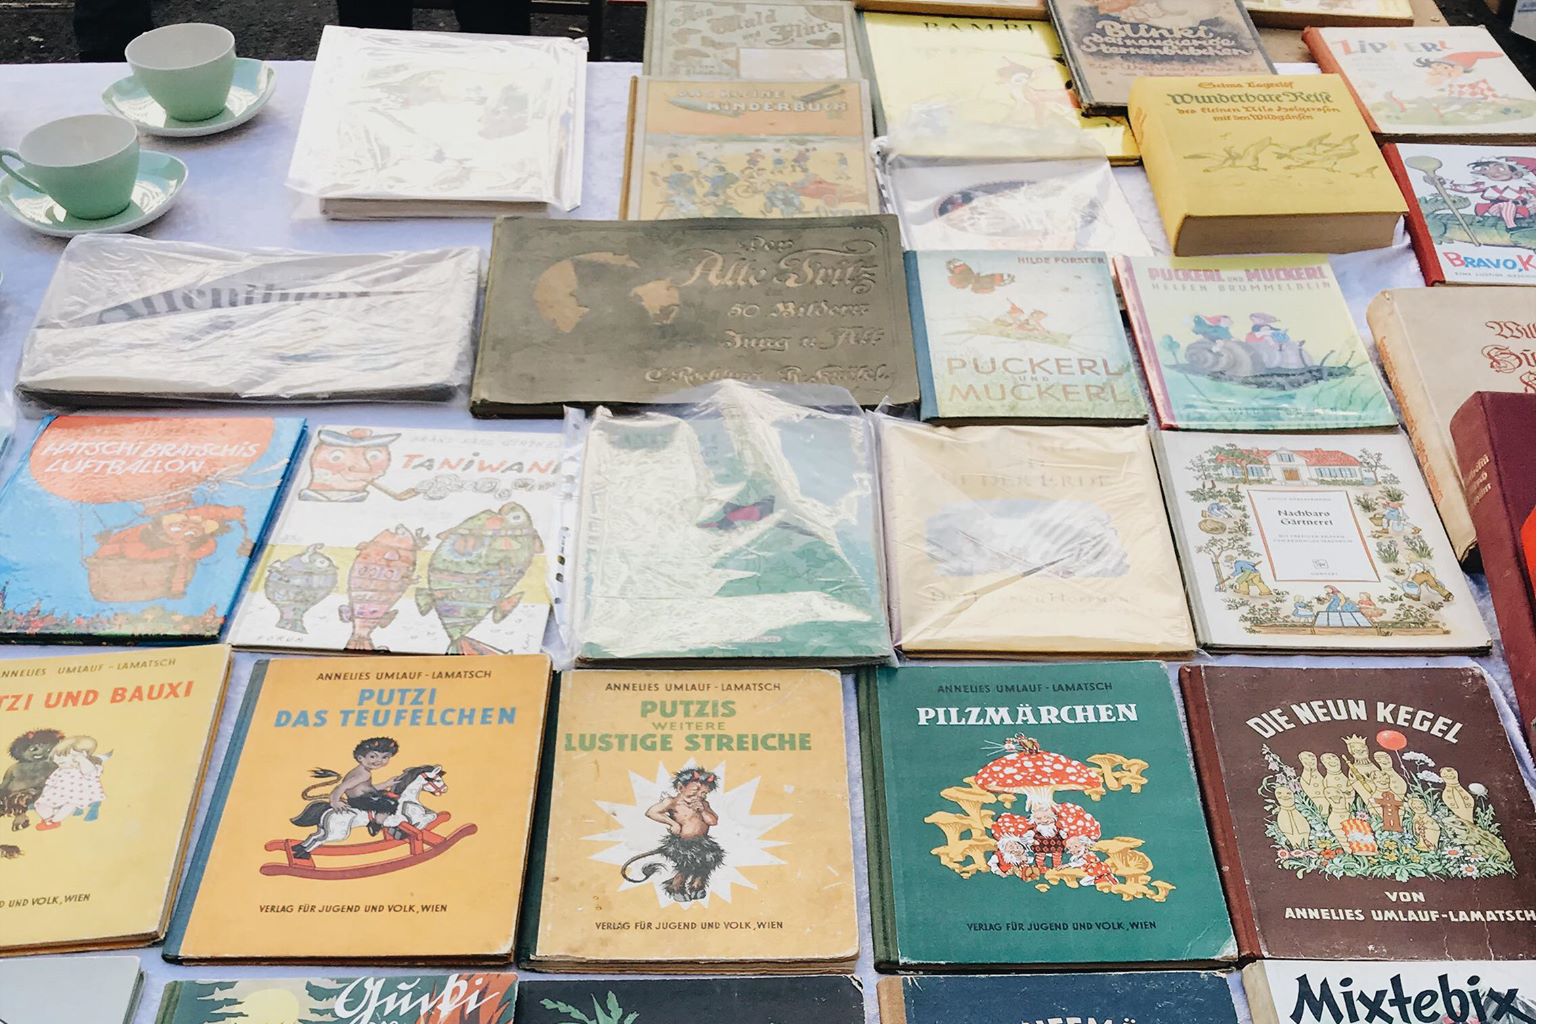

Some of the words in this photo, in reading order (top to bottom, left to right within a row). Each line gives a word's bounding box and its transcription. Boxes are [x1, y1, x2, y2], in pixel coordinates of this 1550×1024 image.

[1167, 92, 1282, 105] Wunderbare
[1017, 256, 1050, 264] HILDE
[1147, 267, 1226, 282] PUCKERL
[1244, 265, 1328, 282] MUCKERL
[1151, 283, 1208, 292] HELFEN
[728, 303, 761, 318] 50
[946, 357, 1125, 376] PUCKERL
[949, 382, 1131, 403] MUCKERL
[44, 457, 205, 476] LUFTBALLON
[316, 671, 371, 681] ANNELIES
[605, 682, 660, 692] ANNELIES
[937, 683, 992, 694] ANNELIES
[44, 689, 98, 709] UND
[109, 681, 194, 704] BAUXI
[357, 688, 437, 706] PUTZI
[640, 700, 737, 718] PUTZIS
[916, 703, 1139, 726] PILZMÄRCHEN
[273, 709, 328, 728] DAS
[339, 707, 517, 727] TEUFELCHEN
[1246, 707, 1297, 740] DIE
[1289, 699, 1369, 725] NEUN
[1376, 701, 1465, 744] KEGEL
[651, 721, 726, 731] WEITERE
[564, 733, 672, 751] LUSTIGE
[685, 732, 812, 751] STREICHE
[8, 899, 30, 908] UND
[64, 893, 91, 903] WIEN
[1384, 891, 1426, 903] VON
[259, 904, 294, 914] VERLAG
[297, 902, 316, 914] FÜR
[318, 904, 360, 914] JUGEND
[363, 904, 385, 913] UND
[420, 903, 448, 913] WIEN
[1284, 907, 1365, 921] ANNELIES
[595, 921, 631, 931] VERLAG
[634, 920, 653, 931] FÜR
[655, 921, 697, 931] JUGEND
[700, 921, 721, 930] UND
[756, 921, 784, 930] WIEN
[966, 922, 1003, 932] VERLAG
[1005, 920, 1025, 932] FÜR
[1027, 922, 1069, 932] JUGEND
[1072, 922, 1093, 932] UND
[1129, 920, 1158, 930] WIEN
[1289, 973, 1536, 1024] Mixtebix
